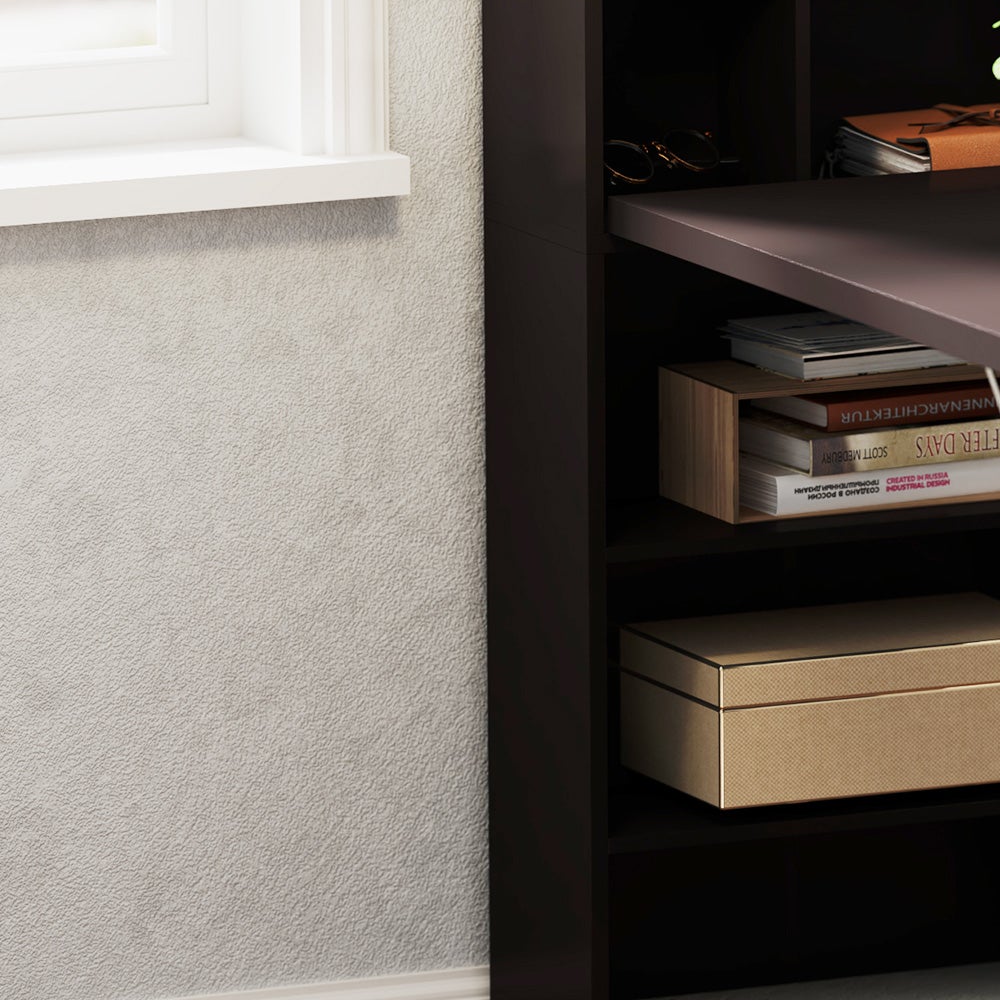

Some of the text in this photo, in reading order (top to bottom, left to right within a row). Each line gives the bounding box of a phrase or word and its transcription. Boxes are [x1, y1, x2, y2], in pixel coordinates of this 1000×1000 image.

[841, 396, 995, 424] NNENARCHITEKTUR
[915, 433, 956, 458] DAYS
[821, 446, 888, 464] SCOTT MEDBURY
[886, 475, 916, 484] CREATED
[925, 472, 949, 481] RUSSIA
[886, 479, 950, 492] INDUSTRIAL DESIGN
[808, 486, 880, 500] СОЗДАНО В РОССИИ
